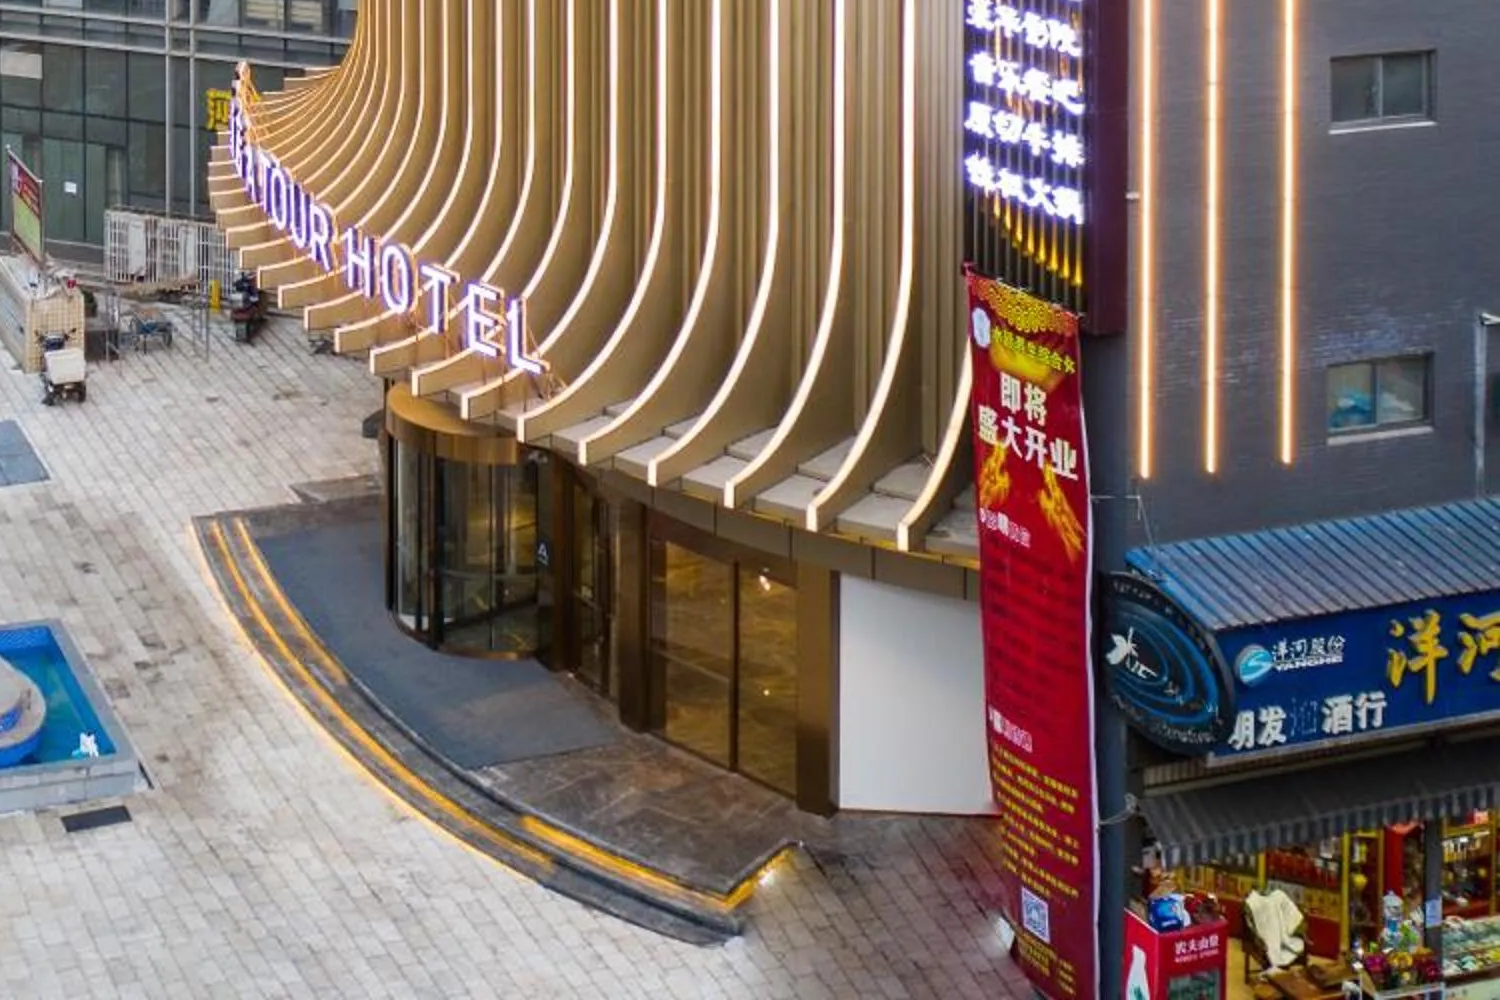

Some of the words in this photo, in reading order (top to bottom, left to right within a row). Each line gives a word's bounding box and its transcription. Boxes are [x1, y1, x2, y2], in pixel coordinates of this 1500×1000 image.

[240, 145, 335, 272] ATOUR
[343, 226, 552, 376] HOTEL
[999, 373, 1047, 426] 即将
[977, 404, 1080, 481] 盛大开业
[1272, 634, 1347, 660] 洋河股份
[1274, 653, 1345, 672] YANGHE
[1386, 609, 1500, 706] 洋河
